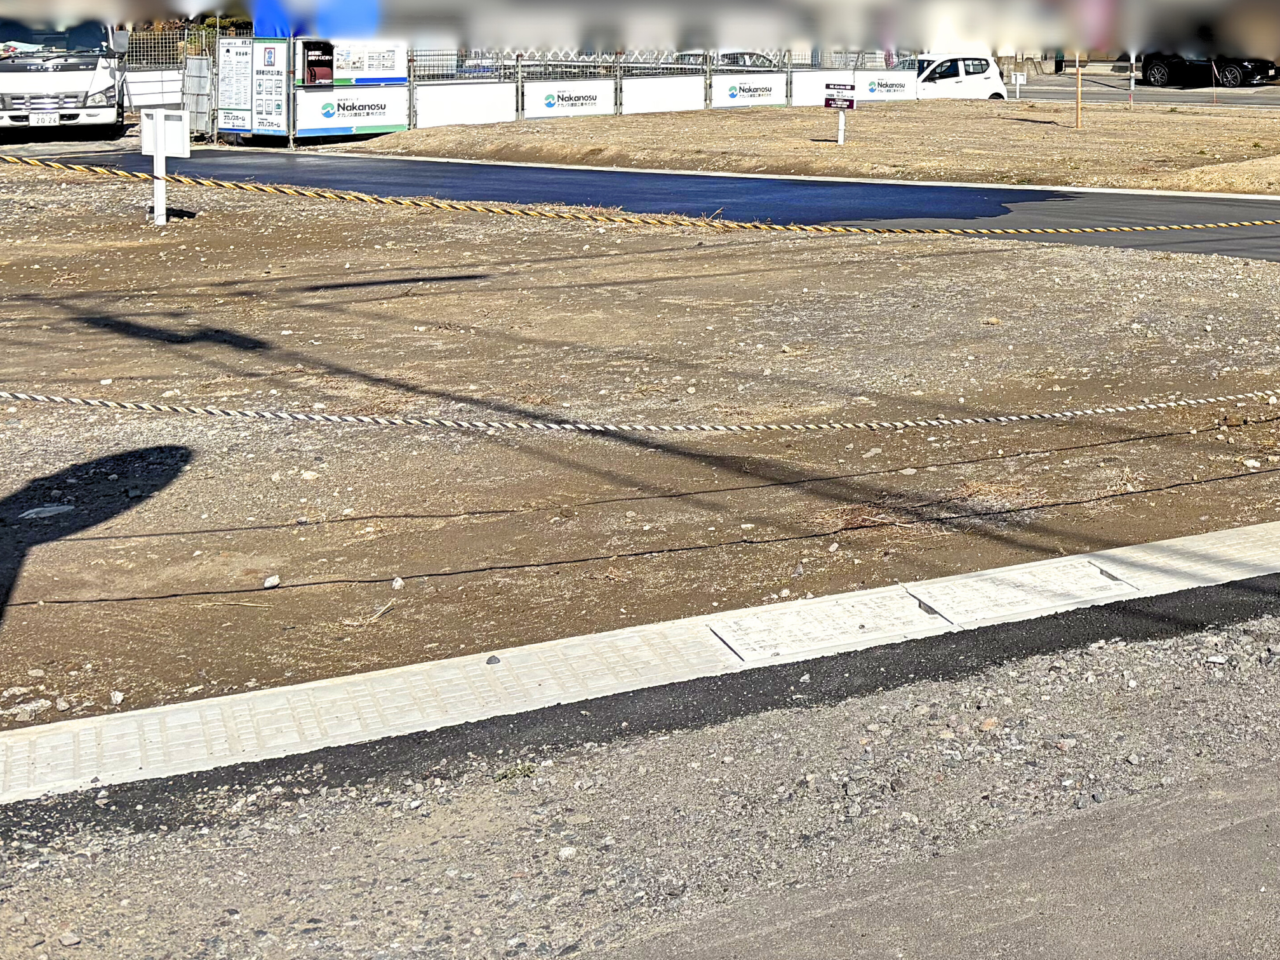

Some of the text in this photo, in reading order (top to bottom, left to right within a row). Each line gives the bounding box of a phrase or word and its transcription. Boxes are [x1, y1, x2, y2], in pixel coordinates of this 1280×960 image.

[877, 81, 906, 89] Nakanosu
[557, 93, 598, 102] Nakanosu
[337, 102, 387, 112] Nakanosu
